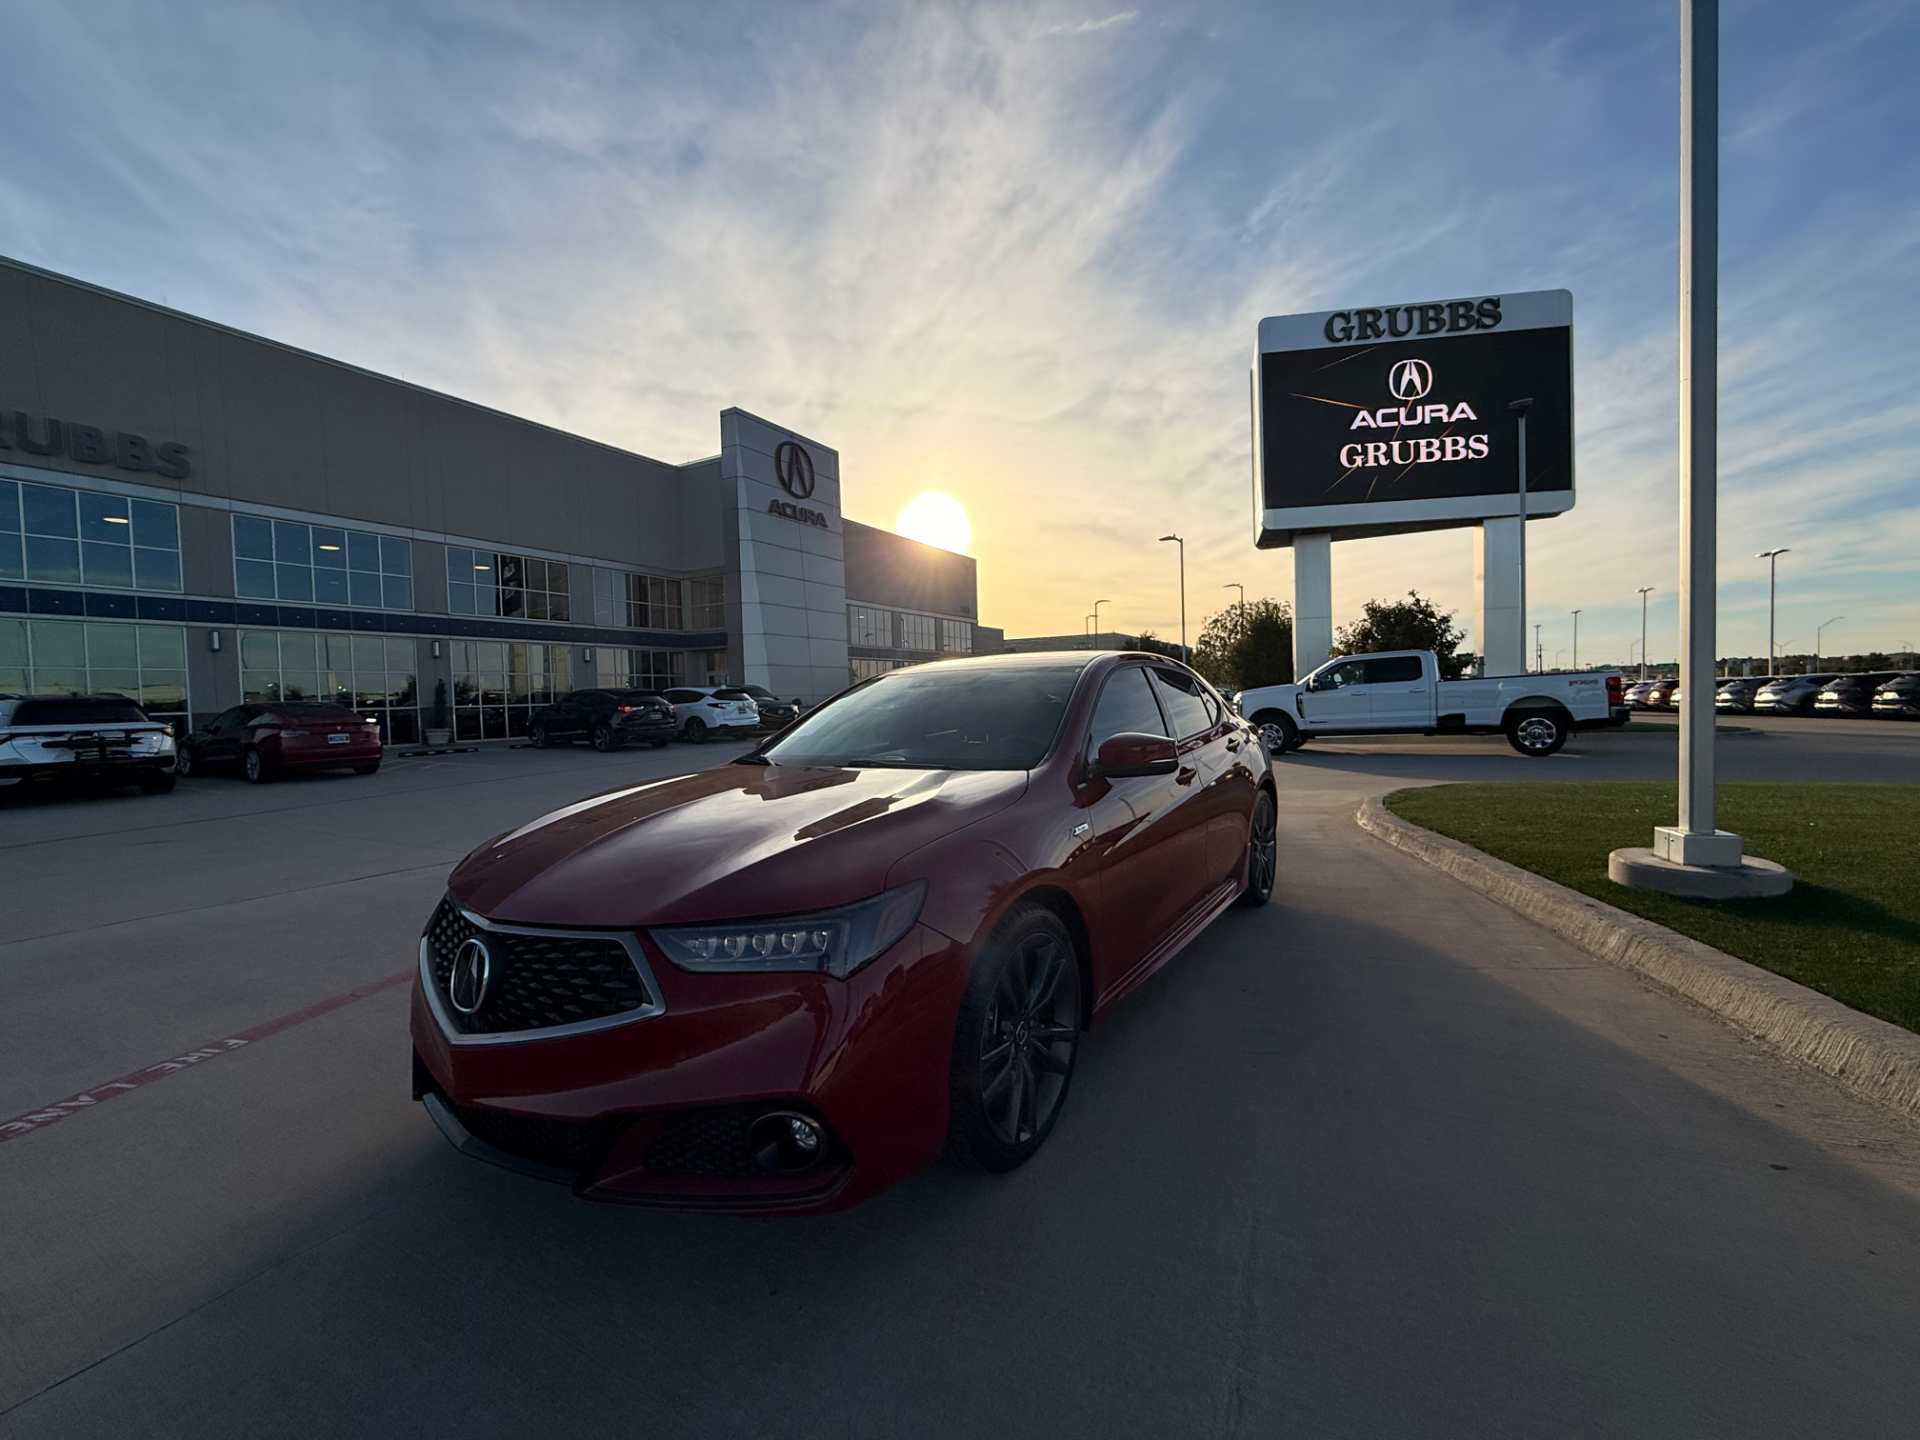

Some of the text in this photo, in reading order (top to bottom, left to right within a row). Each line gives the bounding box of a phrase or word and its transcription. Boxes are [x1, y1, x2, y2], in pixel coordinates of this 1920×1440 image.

[1325, 297, 1502, 343] GRUBBS
[1350, 402, 1477, 430] ACURA
[0, 410, 191, 479] UBBS
[1340, 434, 1489, 468] GRUBBS
[767, 499, 829, 529] ACURA
[0, 1038, 249, 1137] FIRE LANE
